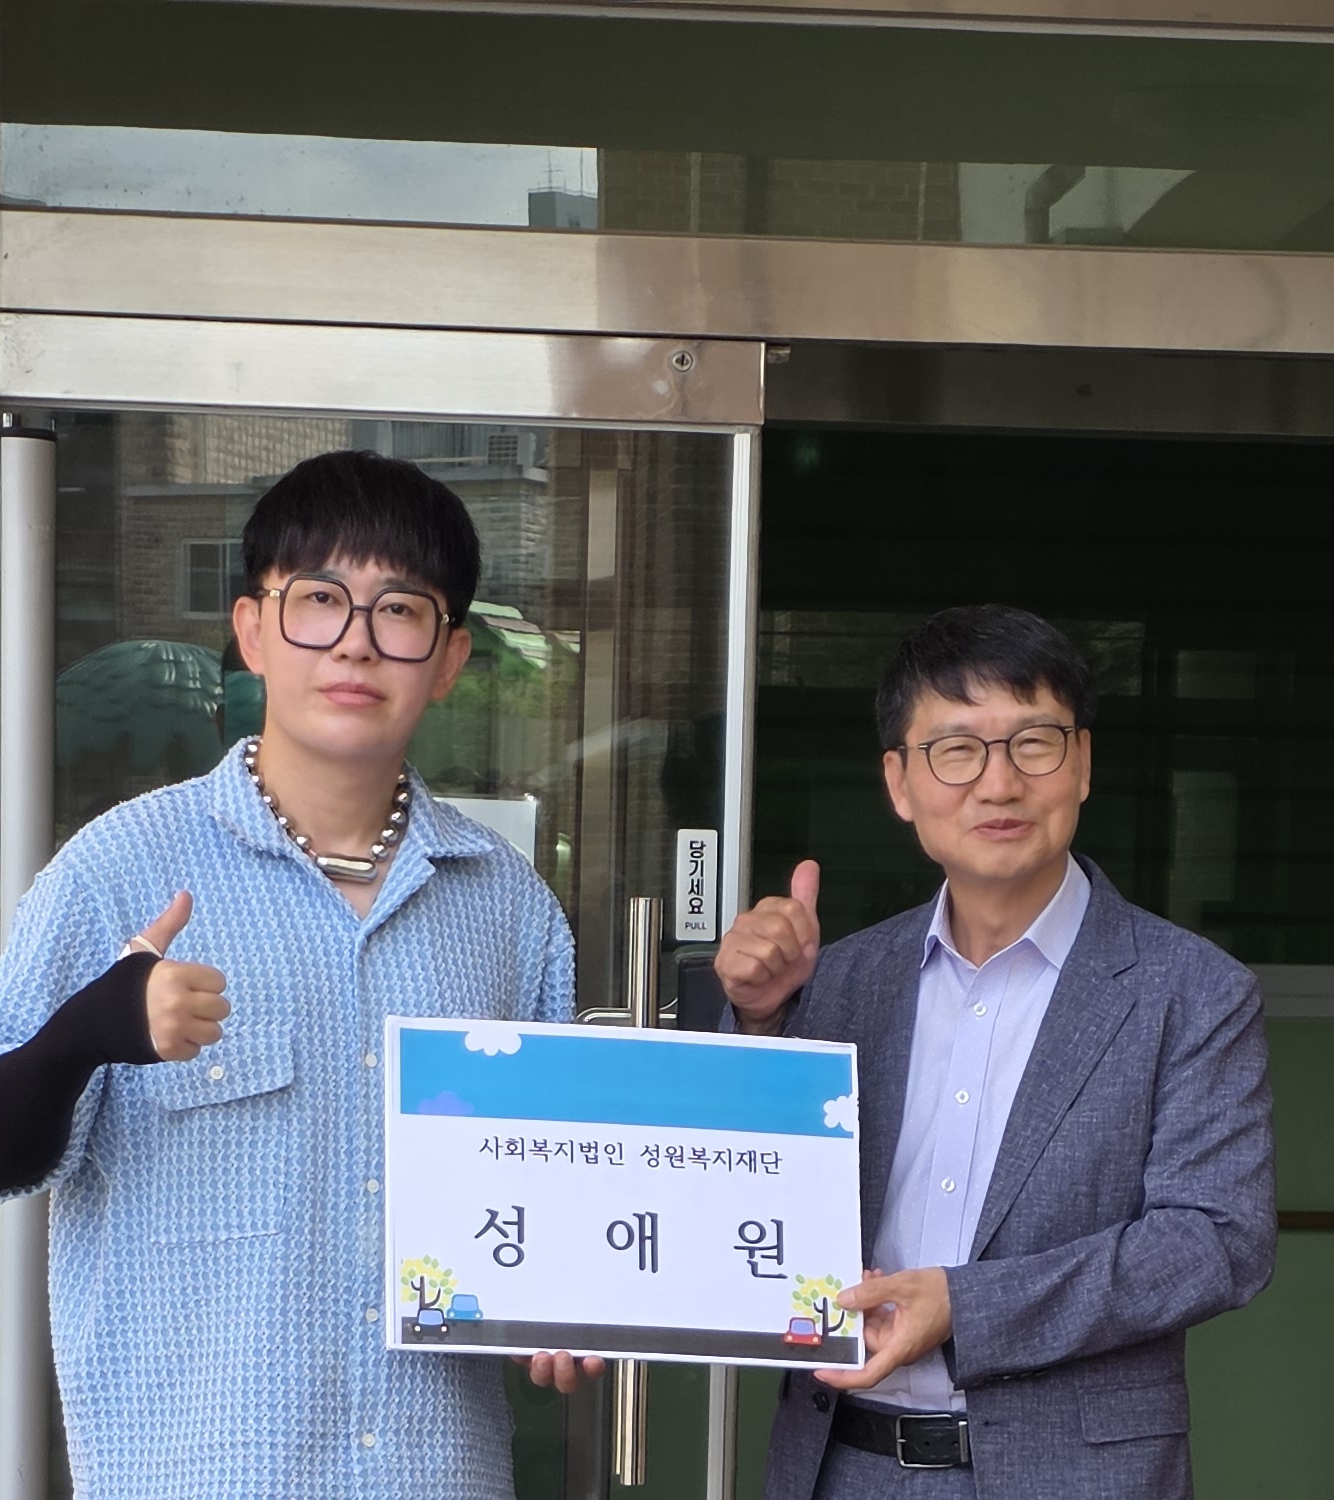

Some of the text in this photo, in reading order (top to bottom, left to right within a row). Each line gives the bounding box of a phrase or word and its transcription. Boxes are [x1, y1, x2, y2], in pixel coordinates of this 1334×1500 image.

[687, 840, 707, 915] 당기세요
[685, 921, 707, 931] PULL
[478, 1136, 783, 1175] 사회복지법인 성원복지재단
[473, 1205, 789, 1280] 성 애 원
